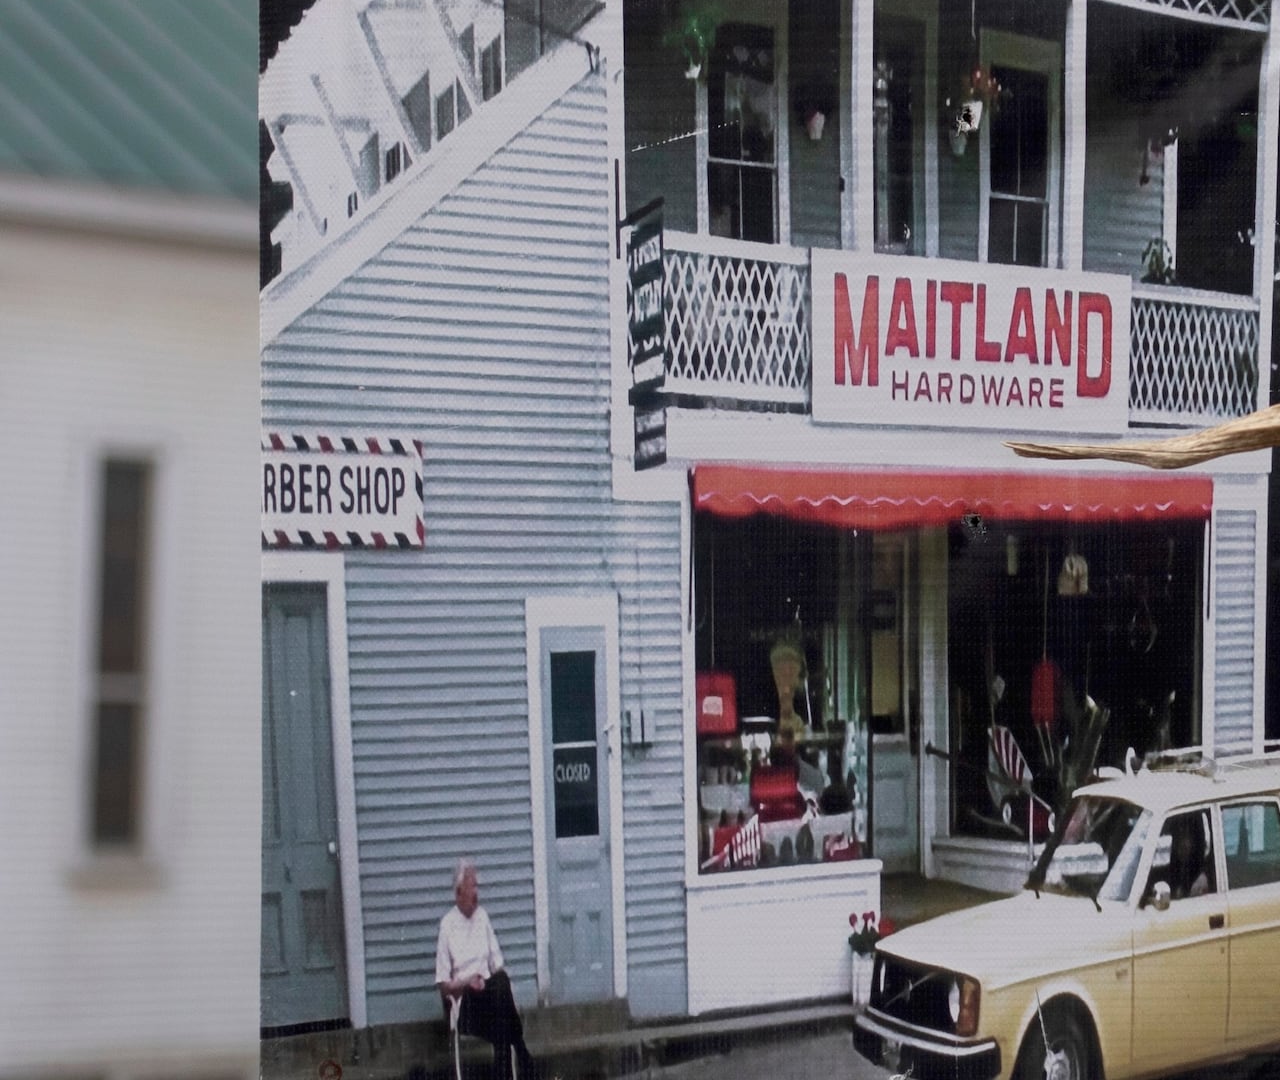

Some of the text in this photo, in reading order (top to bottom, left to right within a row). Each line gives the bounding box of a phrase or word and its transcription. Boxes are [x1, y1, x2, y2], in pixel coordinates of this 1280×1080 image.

[834, 272, 1113, 399] MAITLAND
[891, 370, 1065, 409] HARDWARE
[261, 462, 406, 516] RBER SHOP
